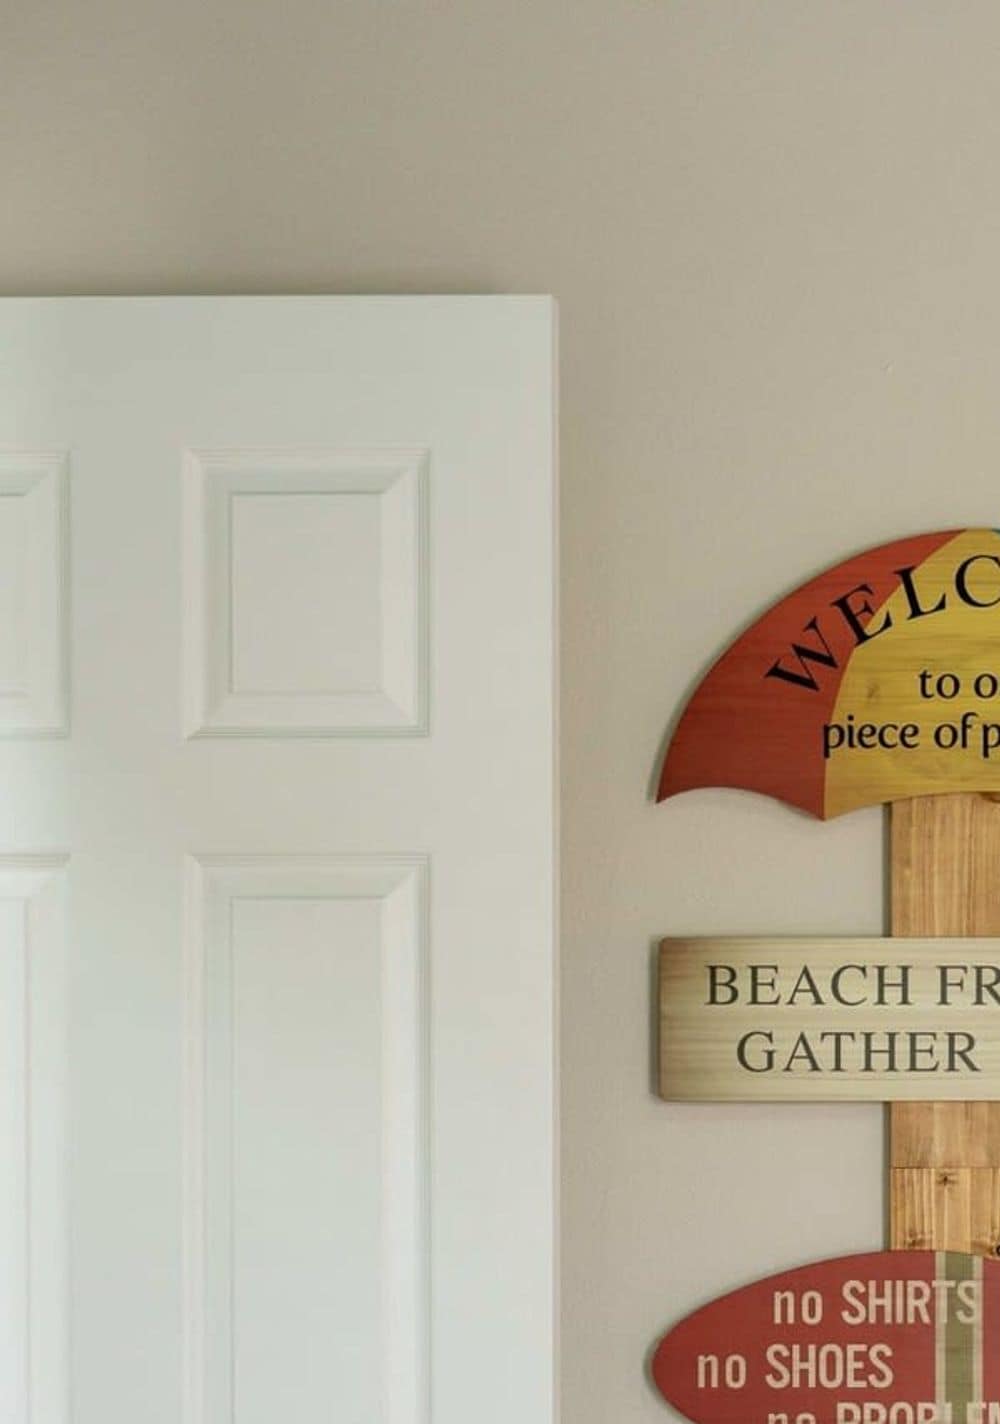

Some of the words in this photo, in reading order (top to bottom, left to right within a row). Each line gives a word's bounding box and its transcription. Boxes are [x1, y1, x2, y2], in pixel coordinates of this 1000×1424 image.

[919, 670, 960, 699] to
[823, 717, 919, 758] piece
[934, 713, 977, 748] of
[706, 965, 912, 1007] BEACH
[736, 1031, 981, 1074] GATHER
[774, 1290, 822, 1324] no
[841, 1280, 981, 1325] SHIRTS
[697, 1354, 745, 1388] no
[765, 1344, 893, 1389] SHOES
